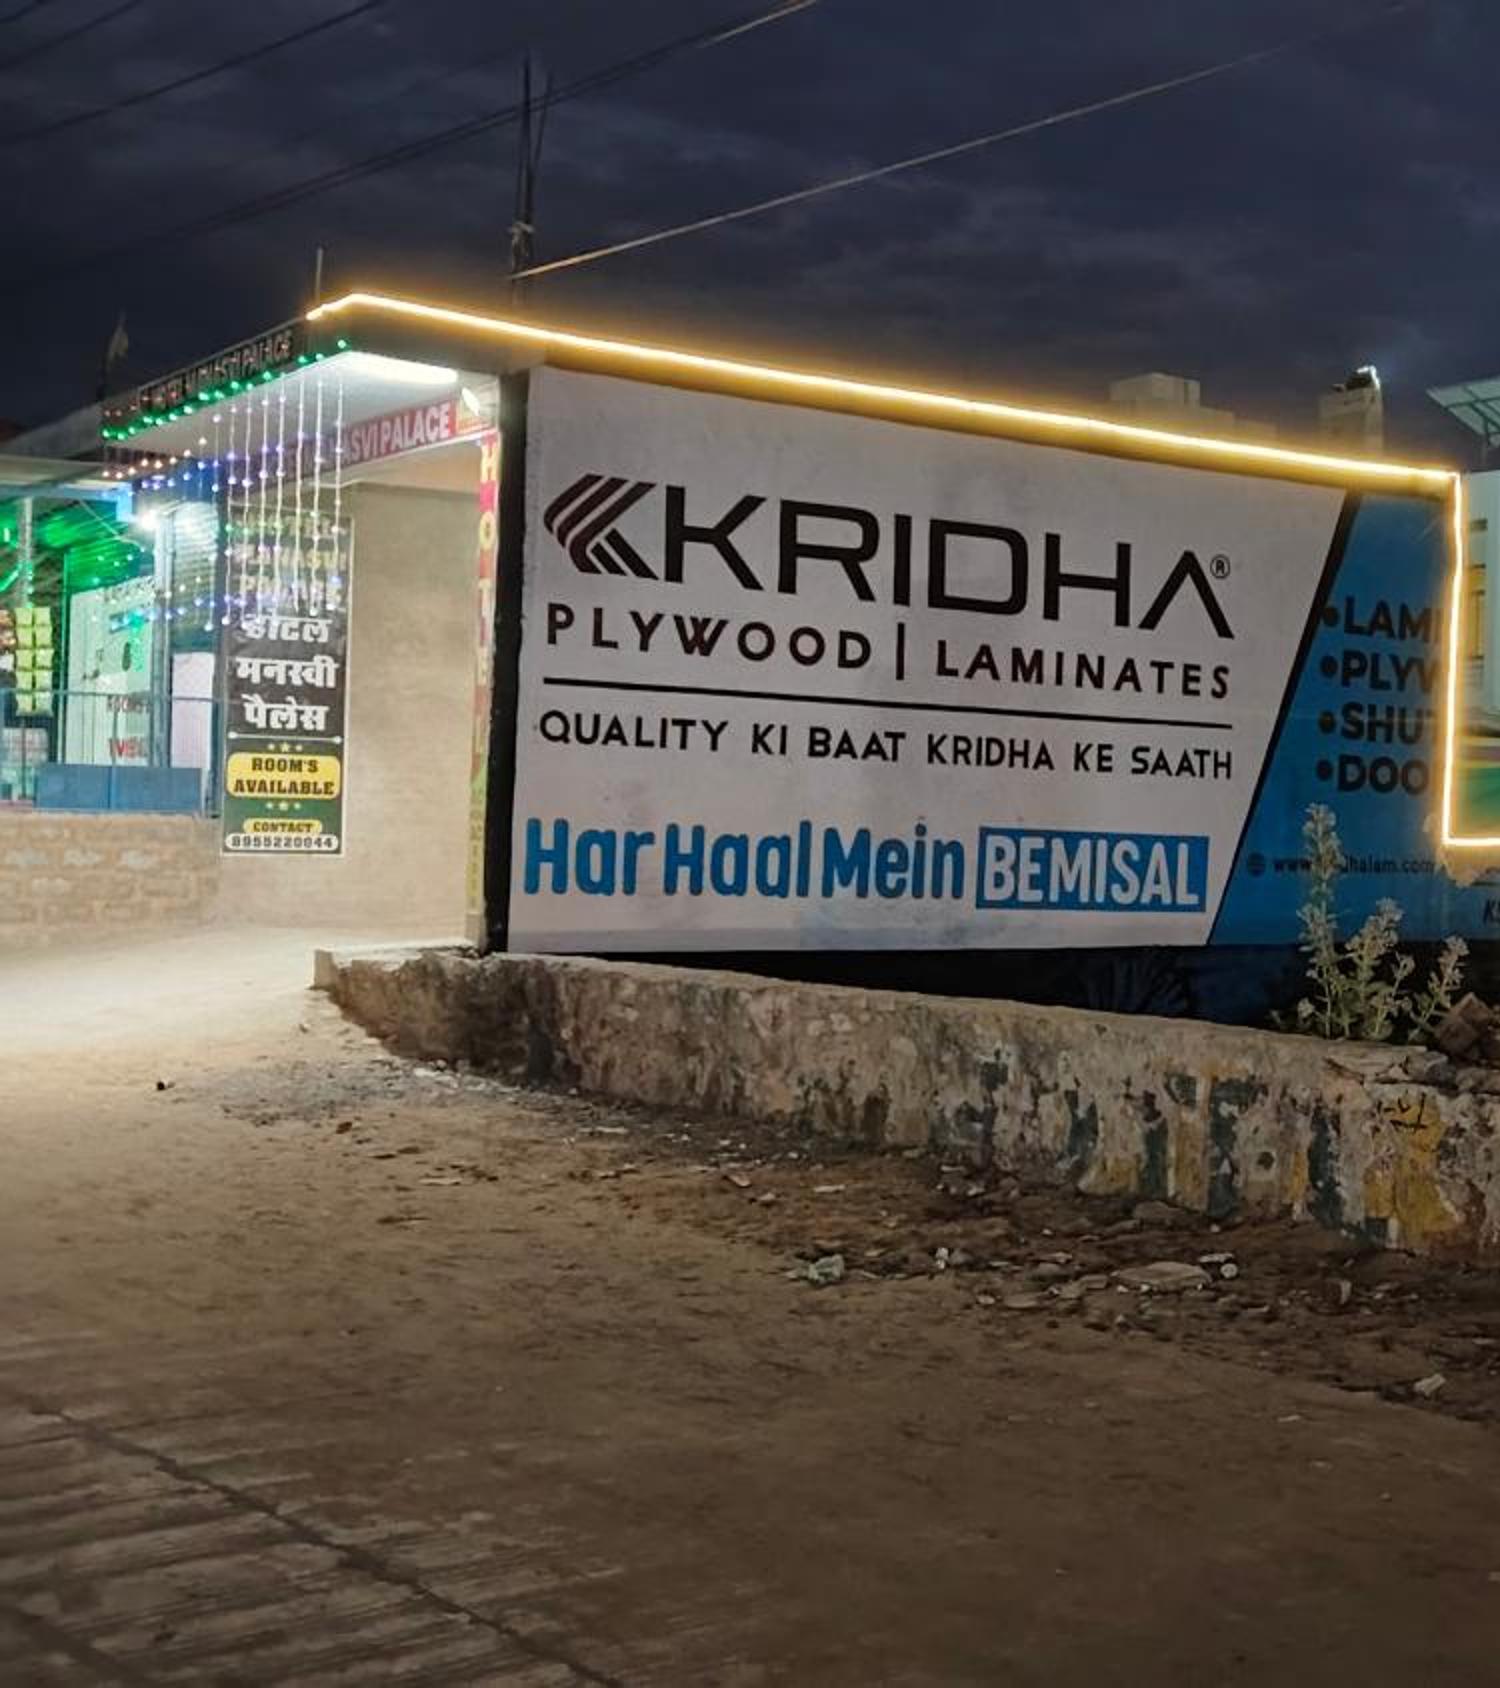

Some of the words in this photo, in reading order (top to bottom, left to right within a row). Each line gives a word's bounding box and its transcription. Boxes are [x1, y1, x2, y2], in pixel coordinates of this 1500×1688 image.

[383, 402, 450, 451] PALACE
[664, 486, 1234, 639] KRIDHA
[547, 602, 872, 669] PLYWOOD
[936, 640, 1230, 699] LAMINATES
[241, 693, 330, 731] पैलेस
[251, 757, 319, 774] ROOM'S
[539, 710, 728, 751] QUALITY
[751, 723, 788, 755] KI
[807, 726, 906, 762] BAAT
[927, 734, 1055, 771] KRIDHA
[1073, 742, 1113, 773] KE
[1131, 746, 1233, 780] SAATH
[233, 779, 335, 796] AVAILABLE
[253, 821, 314, 833] CONTACT
[523, 817, 655, 896] Har
[664, 820, 811, 897] Haal
[821, 817, 963, 899] Mein
[983, 835, 1199, 905] BEMISAL
